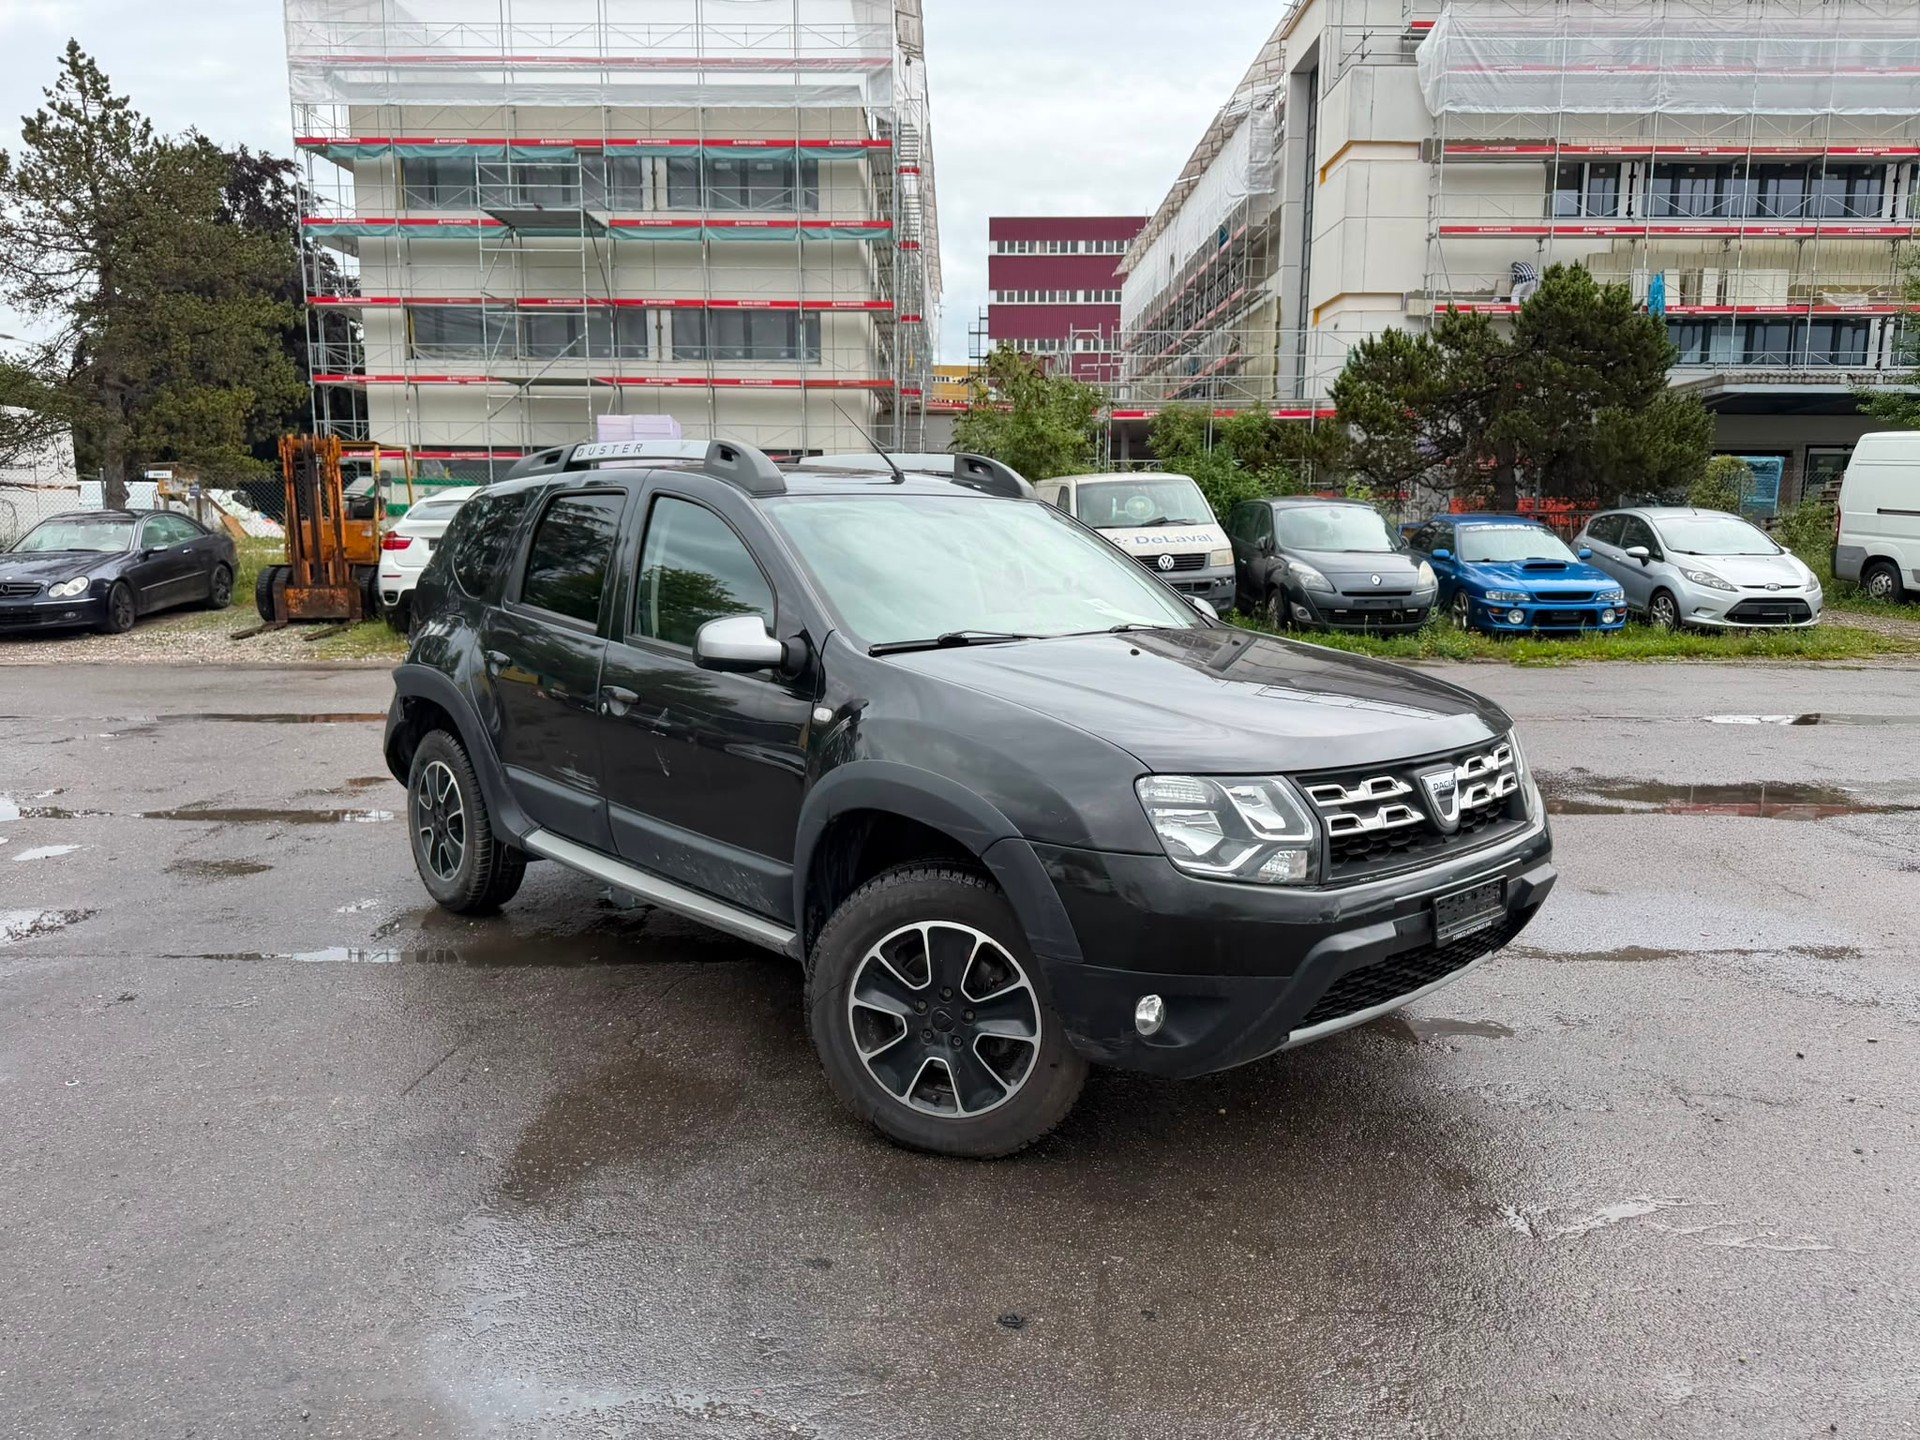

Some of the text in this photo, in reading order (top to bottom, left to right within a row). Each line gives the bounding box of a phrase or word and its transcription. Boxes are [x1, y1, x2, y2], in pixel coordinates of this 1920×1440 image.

[577, 443, 643, 457] DUSTER
[1135, 534, 1213, 545] DeLaval
[1432, 779, 1456, 791] DACIA
